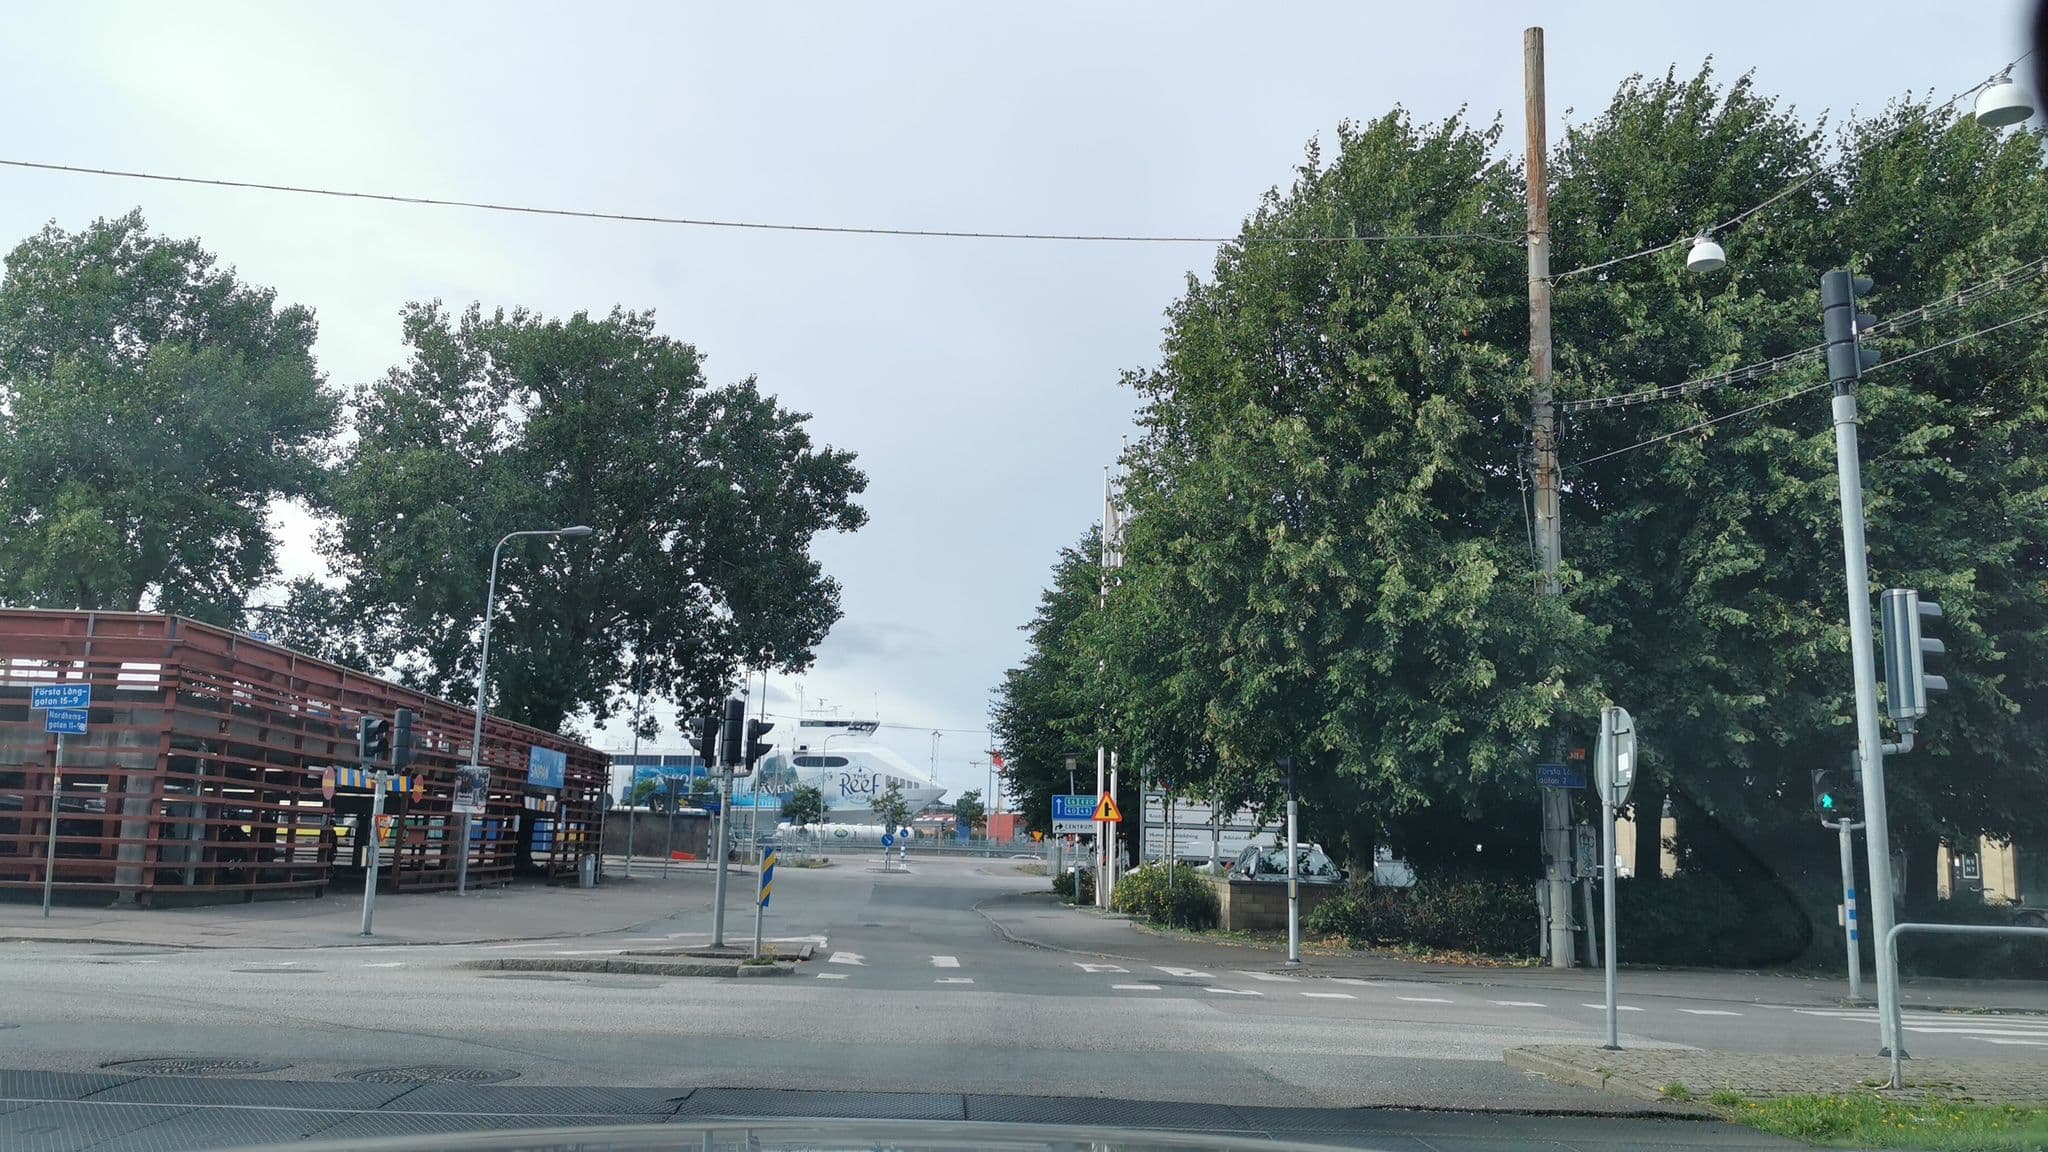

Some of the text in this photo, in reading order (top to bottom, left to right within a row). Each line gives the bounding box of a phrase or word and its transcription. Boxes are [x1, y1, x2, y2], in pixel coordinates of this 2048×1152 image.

[35, 688, 87, 696] Första Lång-
[49, 711, 85, 720] Nordhems-
[48, 721, 67, 729] gatan
[839, 773, 882, 797] Reef
